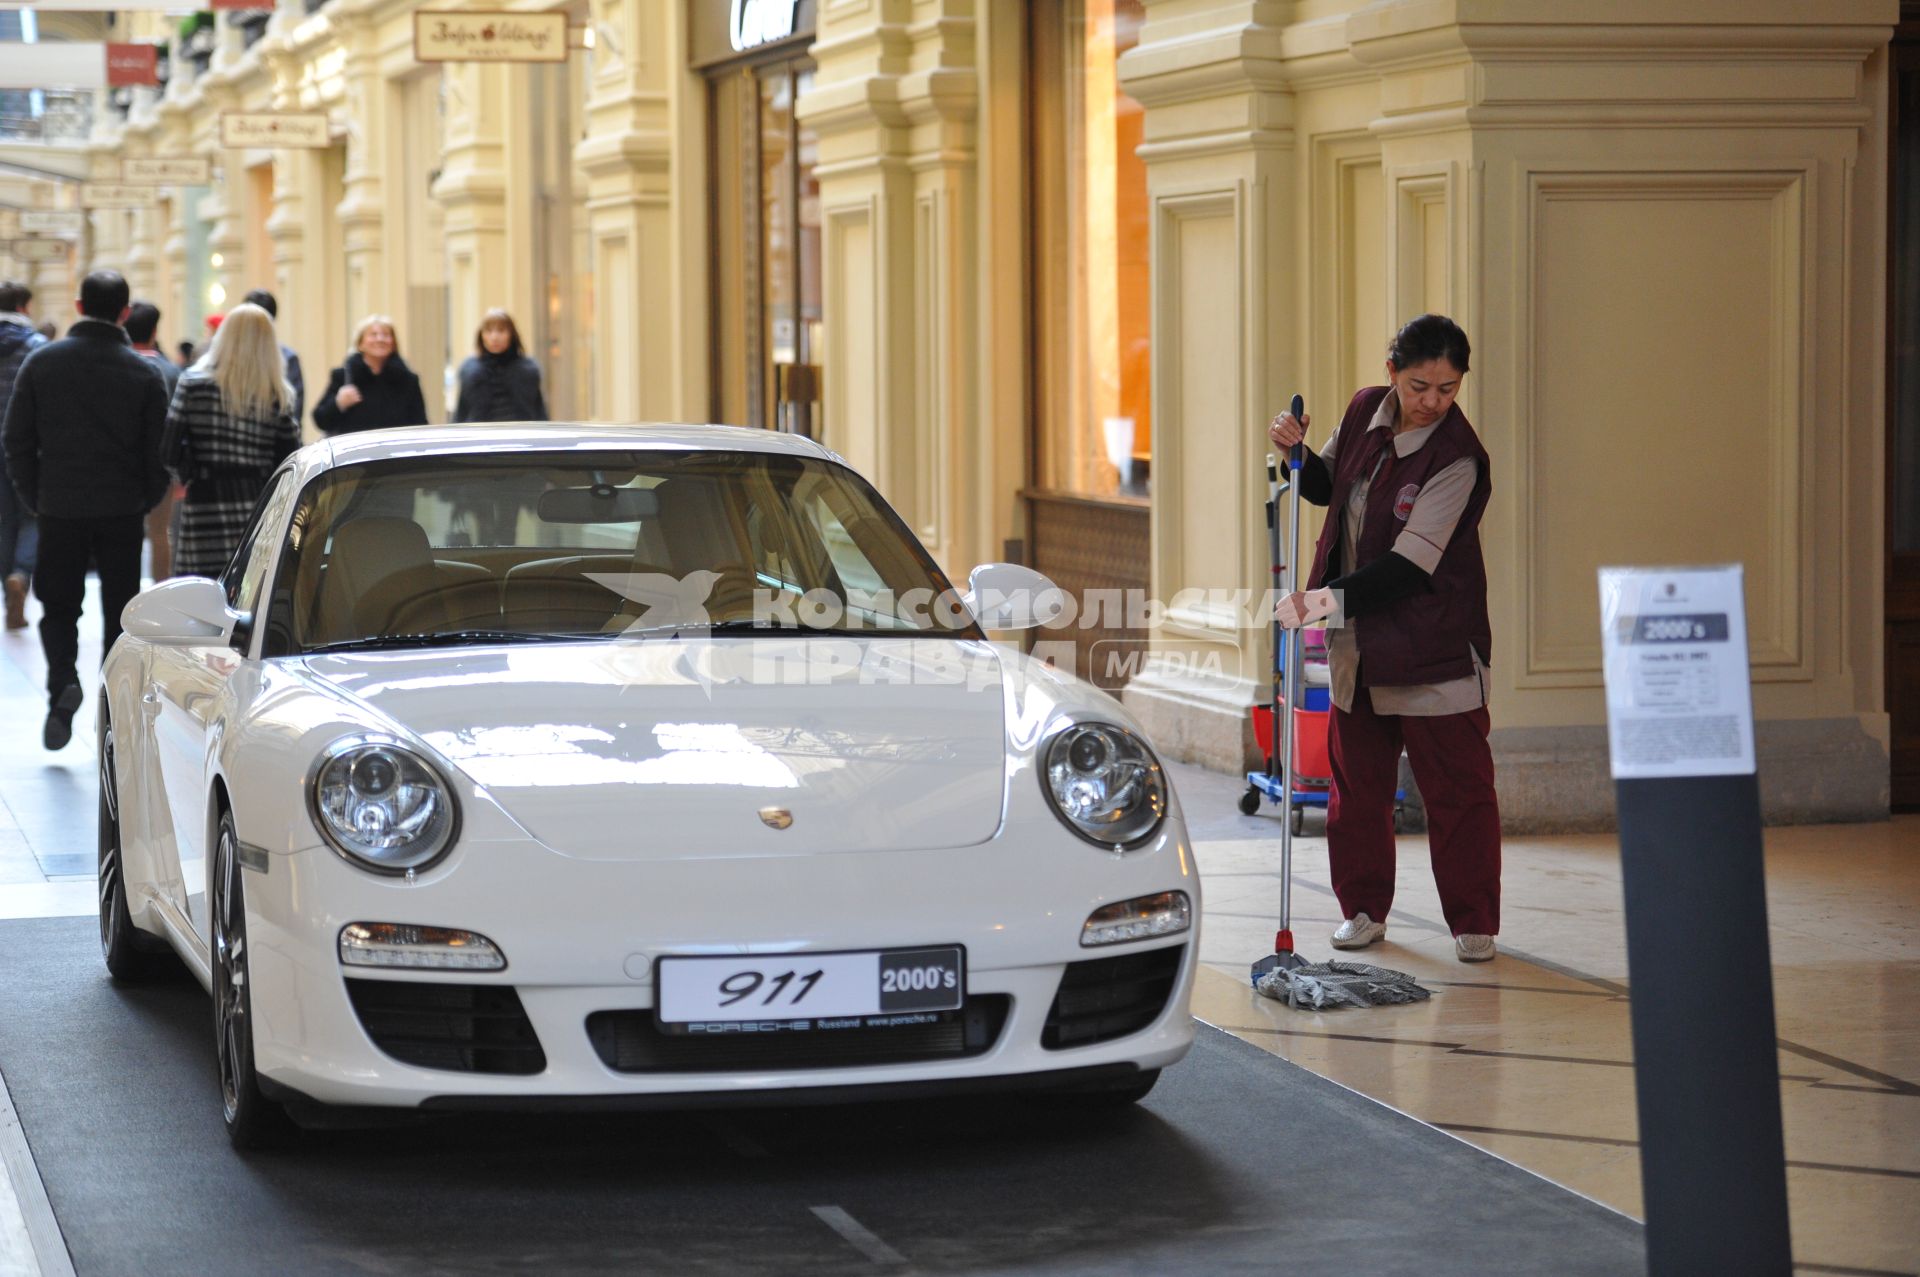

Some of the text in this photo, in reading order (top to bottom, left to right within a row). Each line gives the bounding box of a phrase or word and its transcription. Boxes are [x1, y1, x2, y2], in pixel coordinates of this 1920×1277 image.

[718, 969, 825, 1007] 911
[688, 1021, 810, 1033] PORSCHE
[867, 1014, 937, 1027] www.porsche.ru
